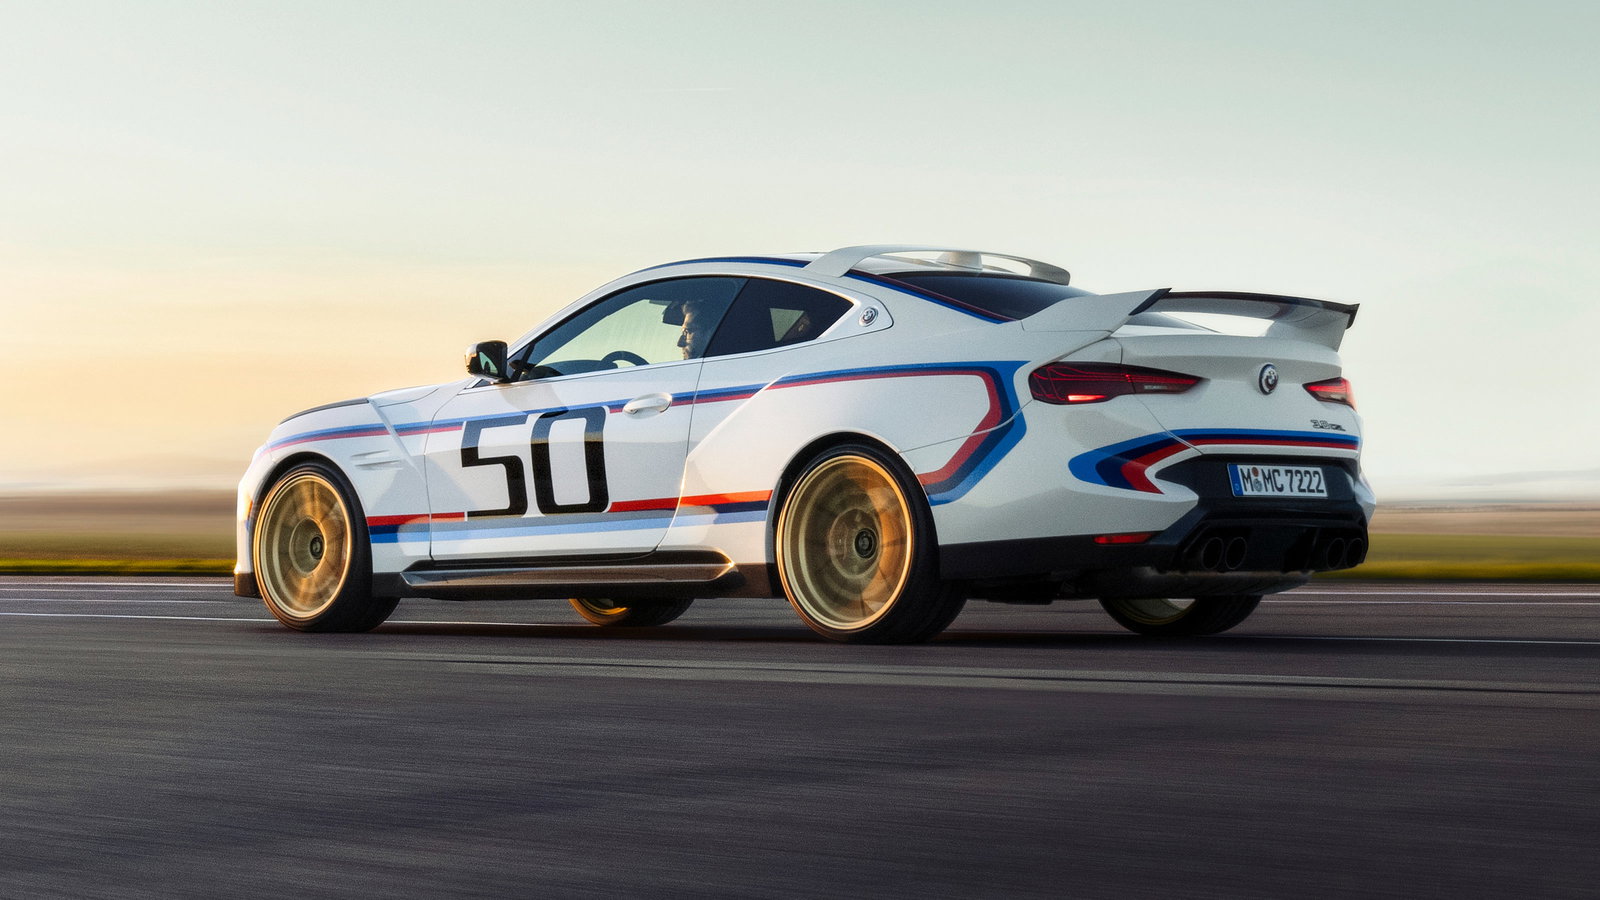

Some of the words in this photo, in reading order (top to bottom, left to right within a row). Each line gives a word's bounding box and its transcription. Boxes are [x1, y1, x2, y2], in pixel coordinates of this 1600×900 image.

[461, 406, 609, 520] 50
[1240, 468, 1254, 492] M
[1261, 468, 1284, 492] MC
[1285, 469, 1324, 493] 7222
